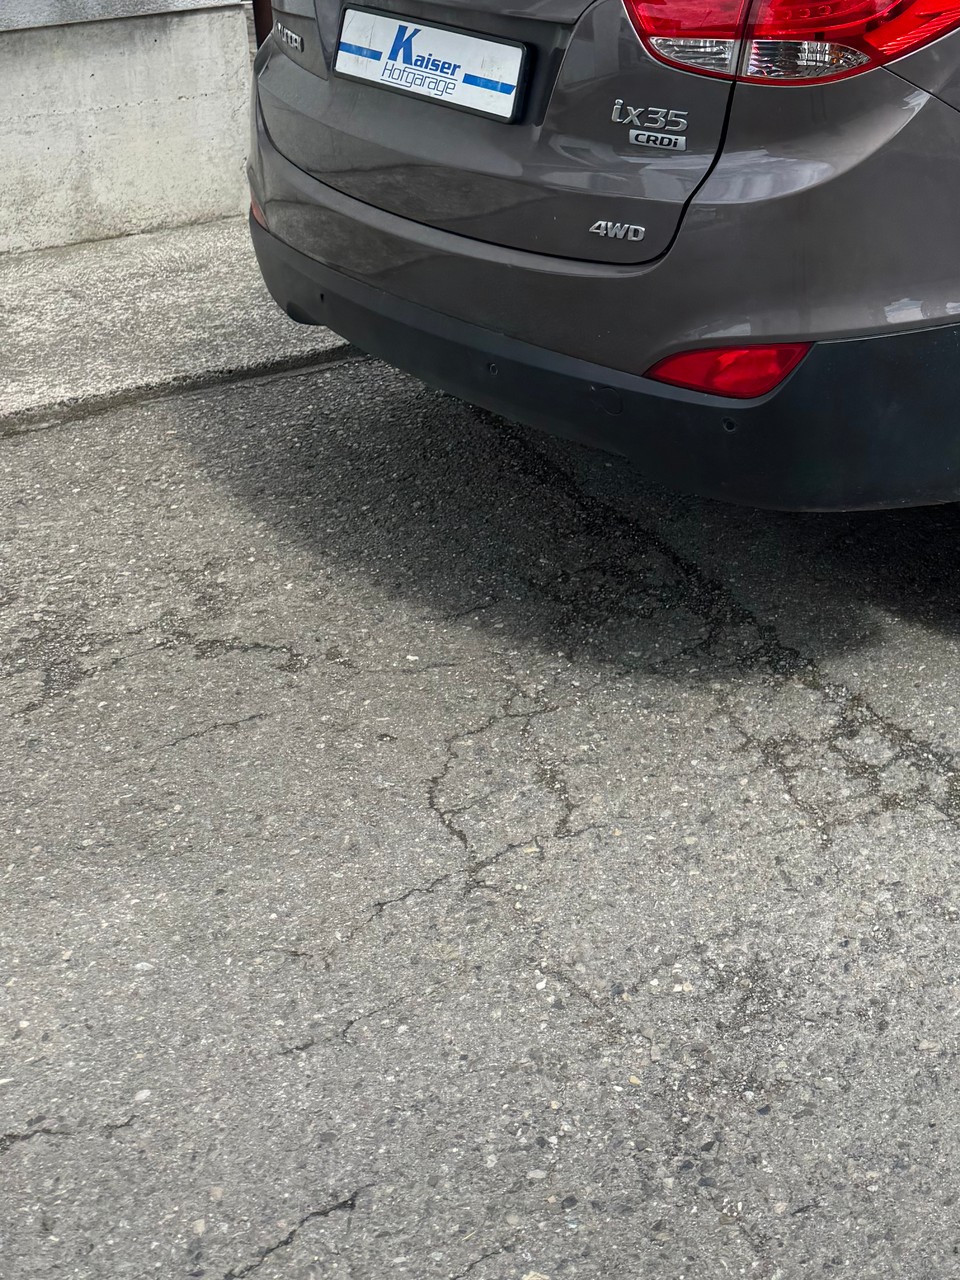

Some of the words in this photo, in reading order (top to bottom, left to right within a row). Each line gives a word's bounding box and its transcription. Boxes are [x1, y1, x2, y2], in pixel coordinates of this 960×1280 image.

[387, 24, 462, 77] Kaiser
[380, 61, 458, 97] Hofgarage
[611, 98, 689, 132] ix35
[634, 133, 679, 148] CRDi
[588, 220, 646, 242] 4WD
